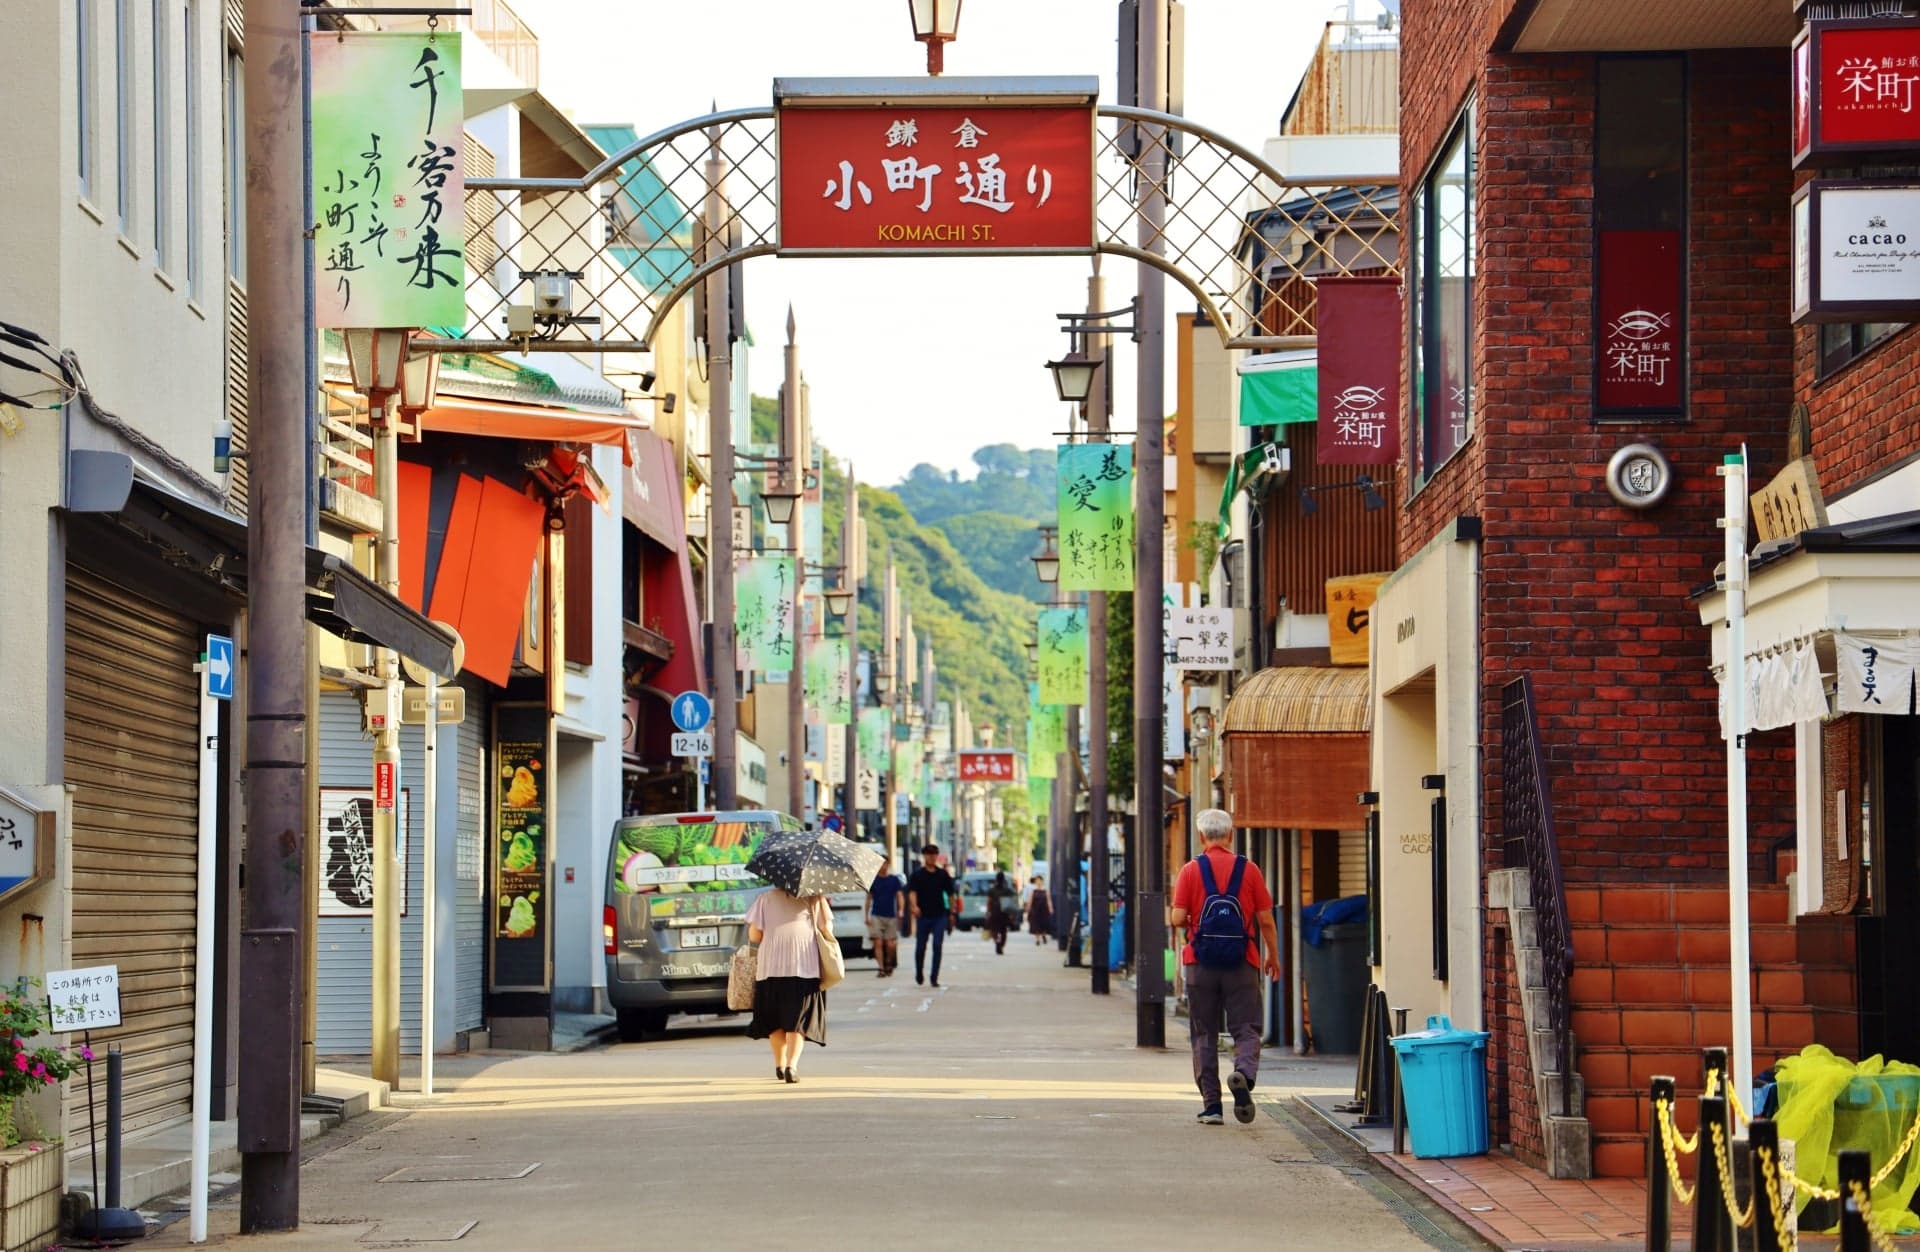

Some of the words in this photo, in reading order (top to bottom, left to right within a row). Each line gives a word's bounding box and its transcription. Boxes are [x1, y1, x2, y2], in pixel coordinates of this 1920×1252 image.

[1836, 58, 1920, 113] 栄町
[885, 118, 988, 148] 鎌倉
[397, 47, 462, 289] 千客万来
[823, 153, 1052, 213] 小町通り
[360, 133, 388, 257] ようこそ
[324, 170, 364, 312] 小町通り
[878, 224, 965, 241] KOMACHI
[971, 224, 996, 241] ST.
[1848, 234, 1906, 245] cacao
[1606, 342, 1671, 386] 栄町
[1333, 411, 1386, 448] 栄町
[768, 563, 792, 656] 千客万来
[676, 738, 709, 752] 12-16
[53, 975, 113, 990] この場所での
